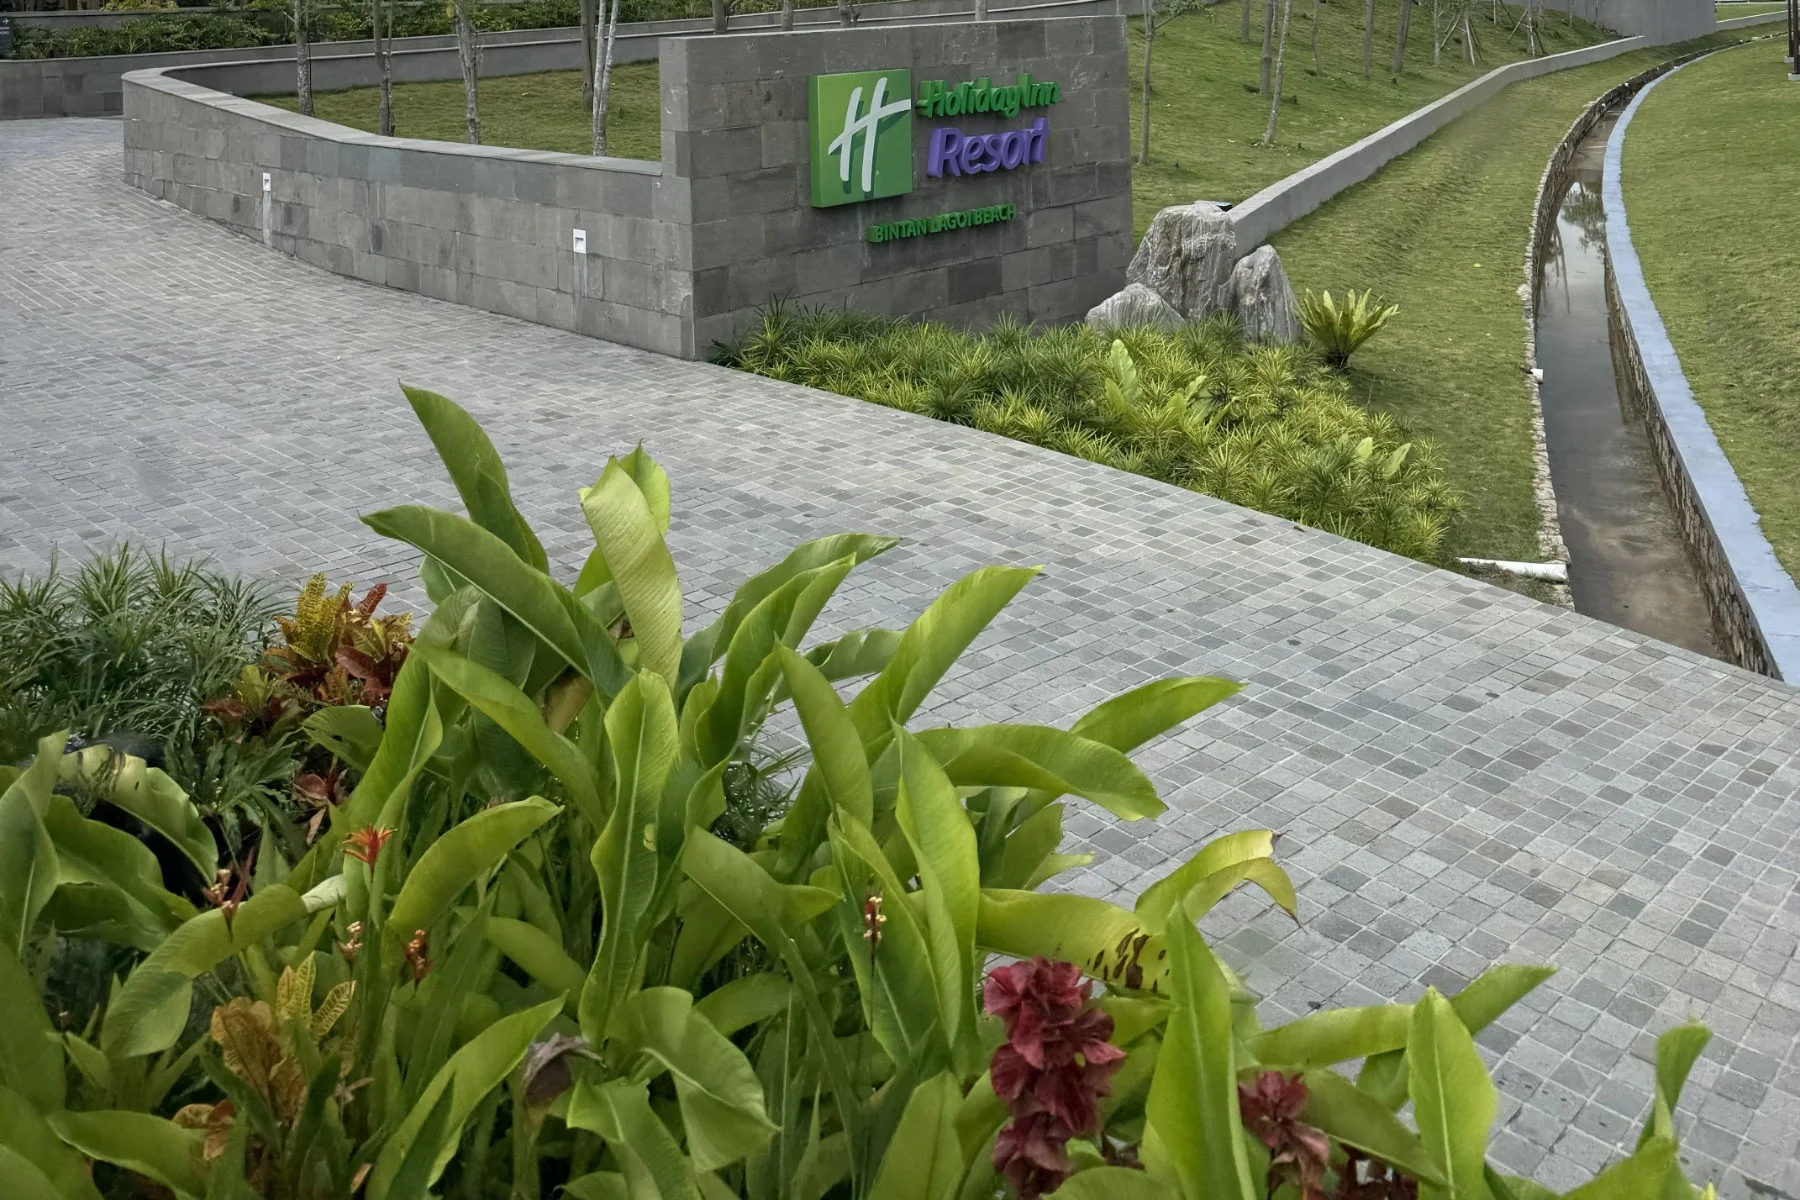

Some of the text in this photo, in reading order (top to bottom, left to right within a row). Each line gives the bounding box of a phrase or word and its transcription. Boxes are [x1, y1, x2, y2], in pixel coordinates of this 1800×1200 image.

[916, 73, 1060, 119] Holiday Inn
[926, 117, 1049, 178] Resort
[868, 204, 1016, 242] BINTAN LAGOI BEACH
